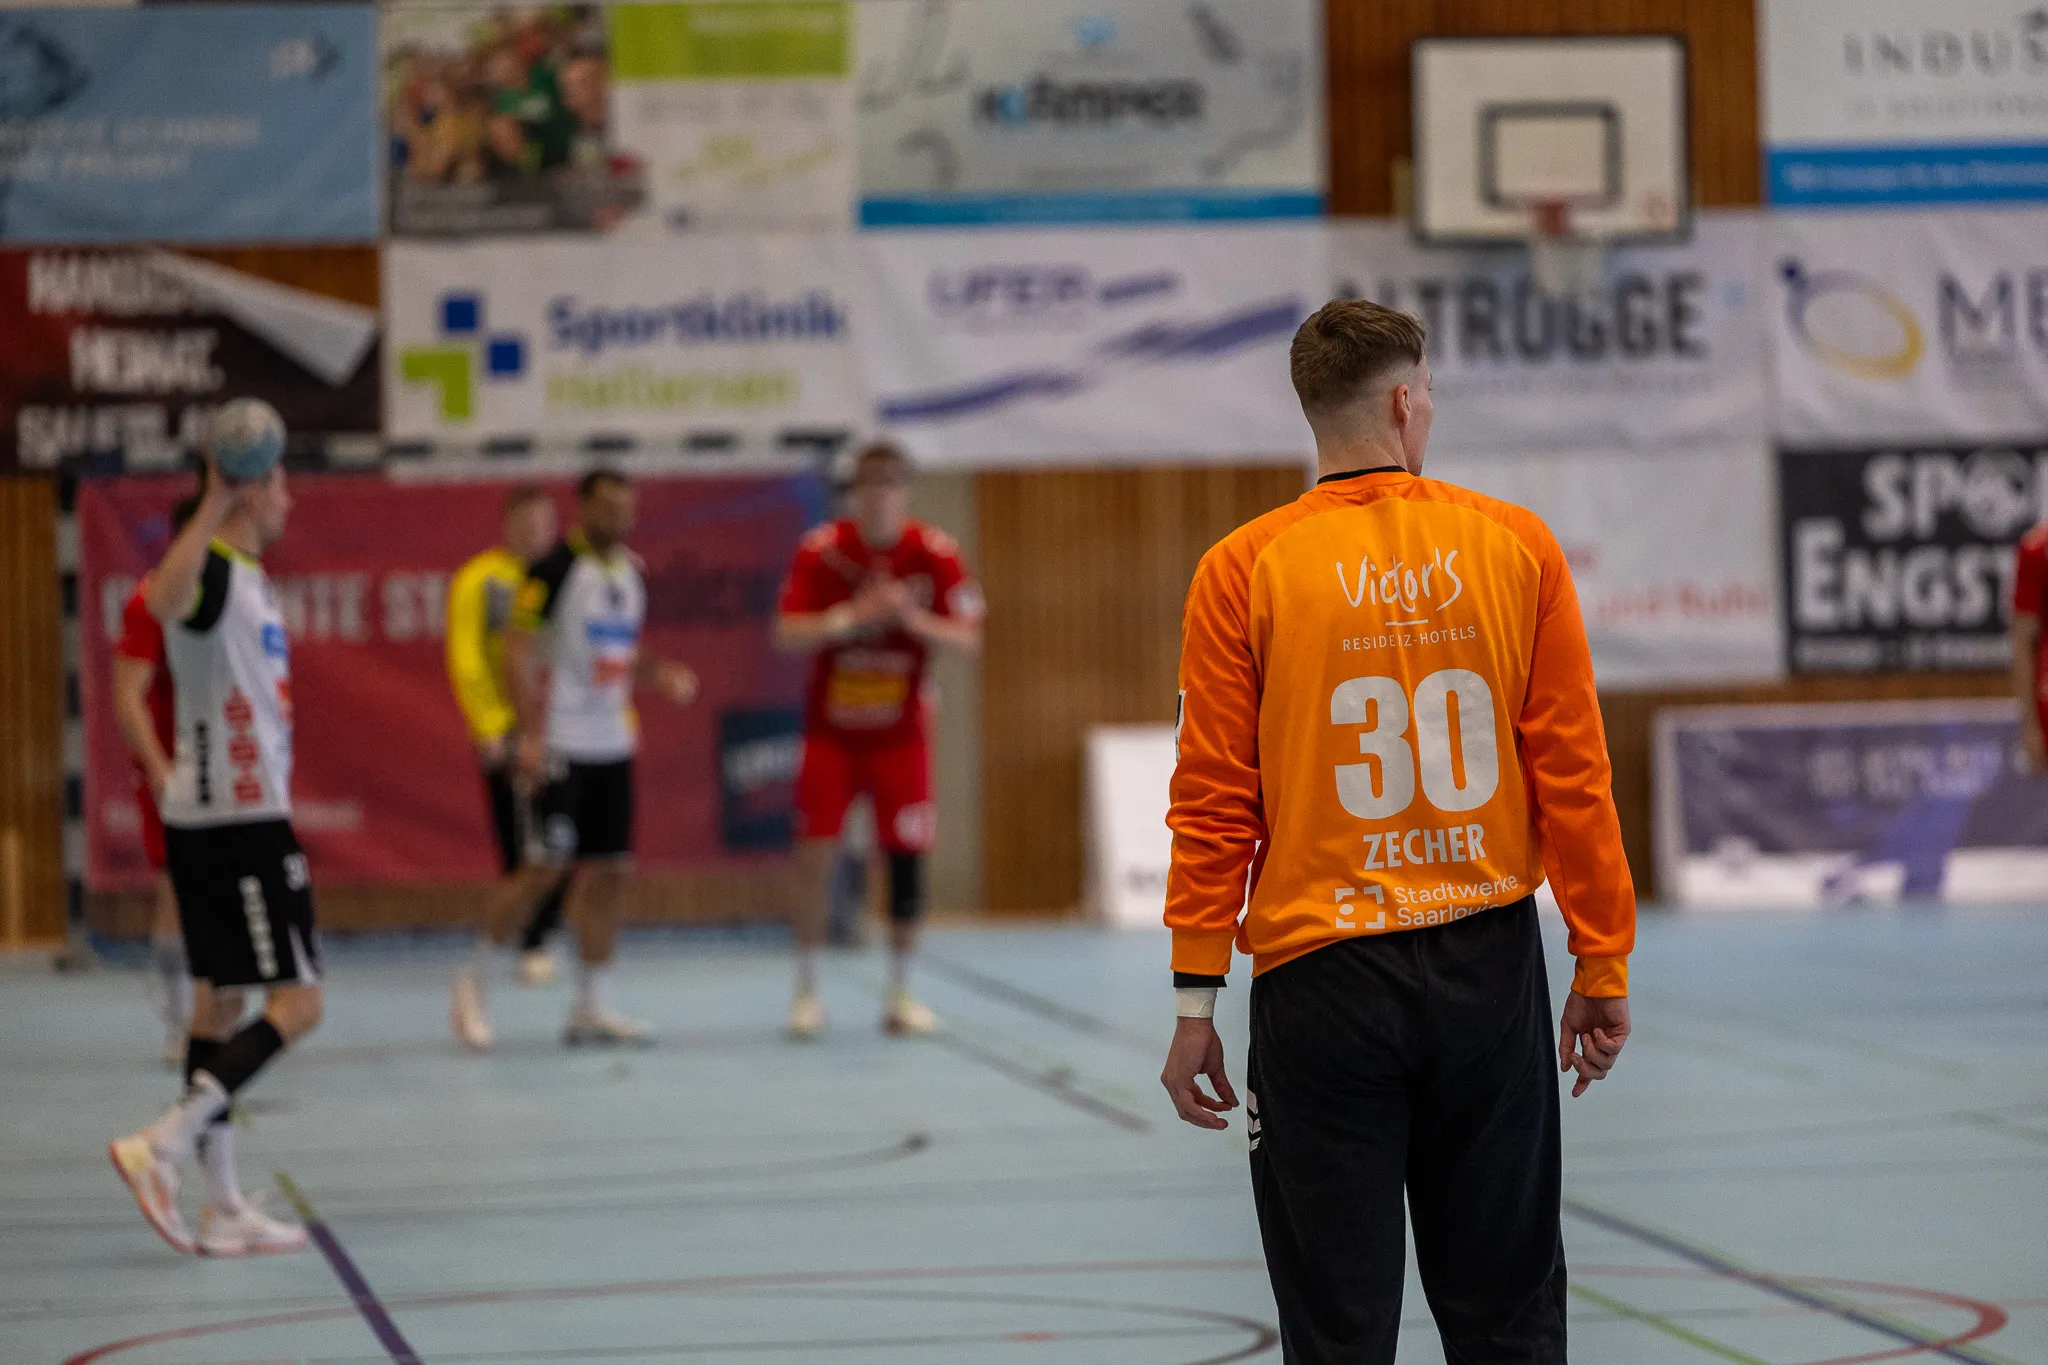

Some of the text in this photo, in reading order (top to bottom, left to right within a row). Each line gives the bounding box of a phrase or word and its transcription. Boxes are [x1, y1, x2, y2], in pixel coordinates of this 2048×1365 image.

[549, 294, 846, 354] Sportklinik
[1336, 547, 1463, 613] Victor's
[1330, 668, 1500, 820] 30
[1363, 823, 1487, 871] ZECHER
[1394, 875, 1519, 904] Stadtwerke
